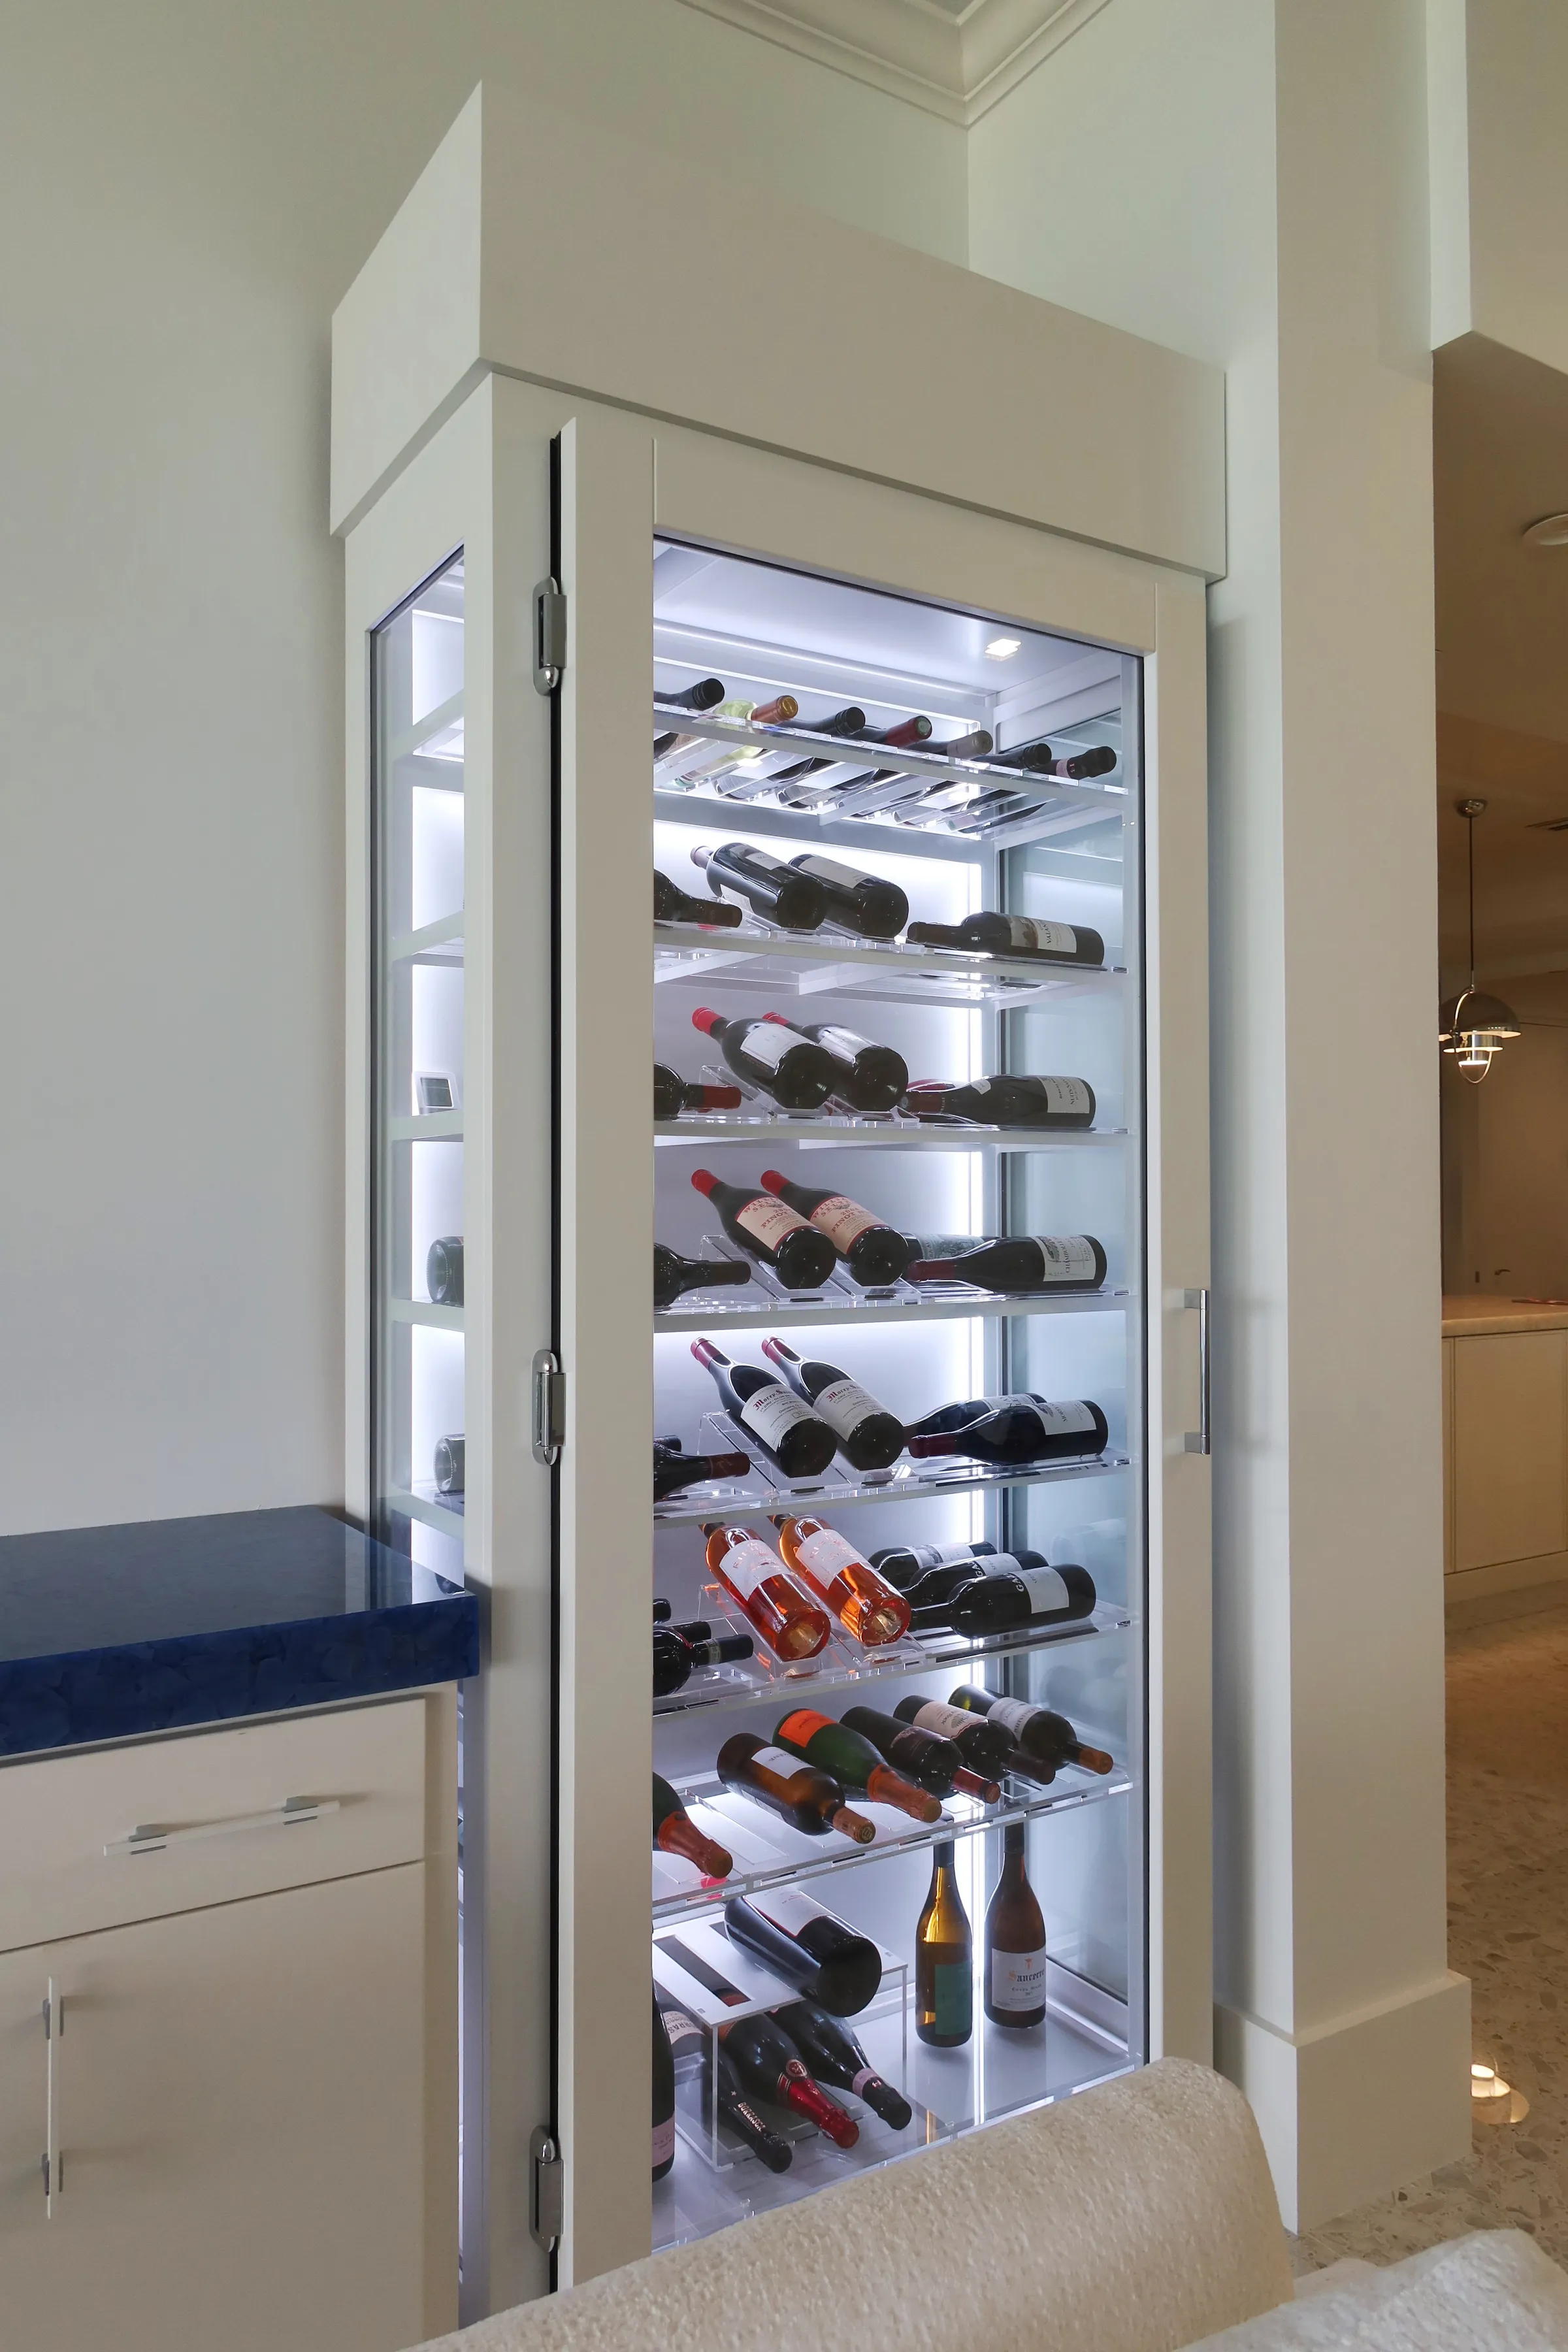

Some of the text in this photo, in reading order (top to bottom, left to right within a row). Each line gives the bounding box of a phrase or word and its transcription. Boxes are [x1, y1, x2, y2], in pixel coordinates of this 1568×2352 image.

[760, 1211, 789, 1229] PINOT
[832, 1212, 856, 1233] PINOT
[1008, 1969, 1045, 1983] Sancerre
[737, 2100, 766, 2132] BORRASCA
